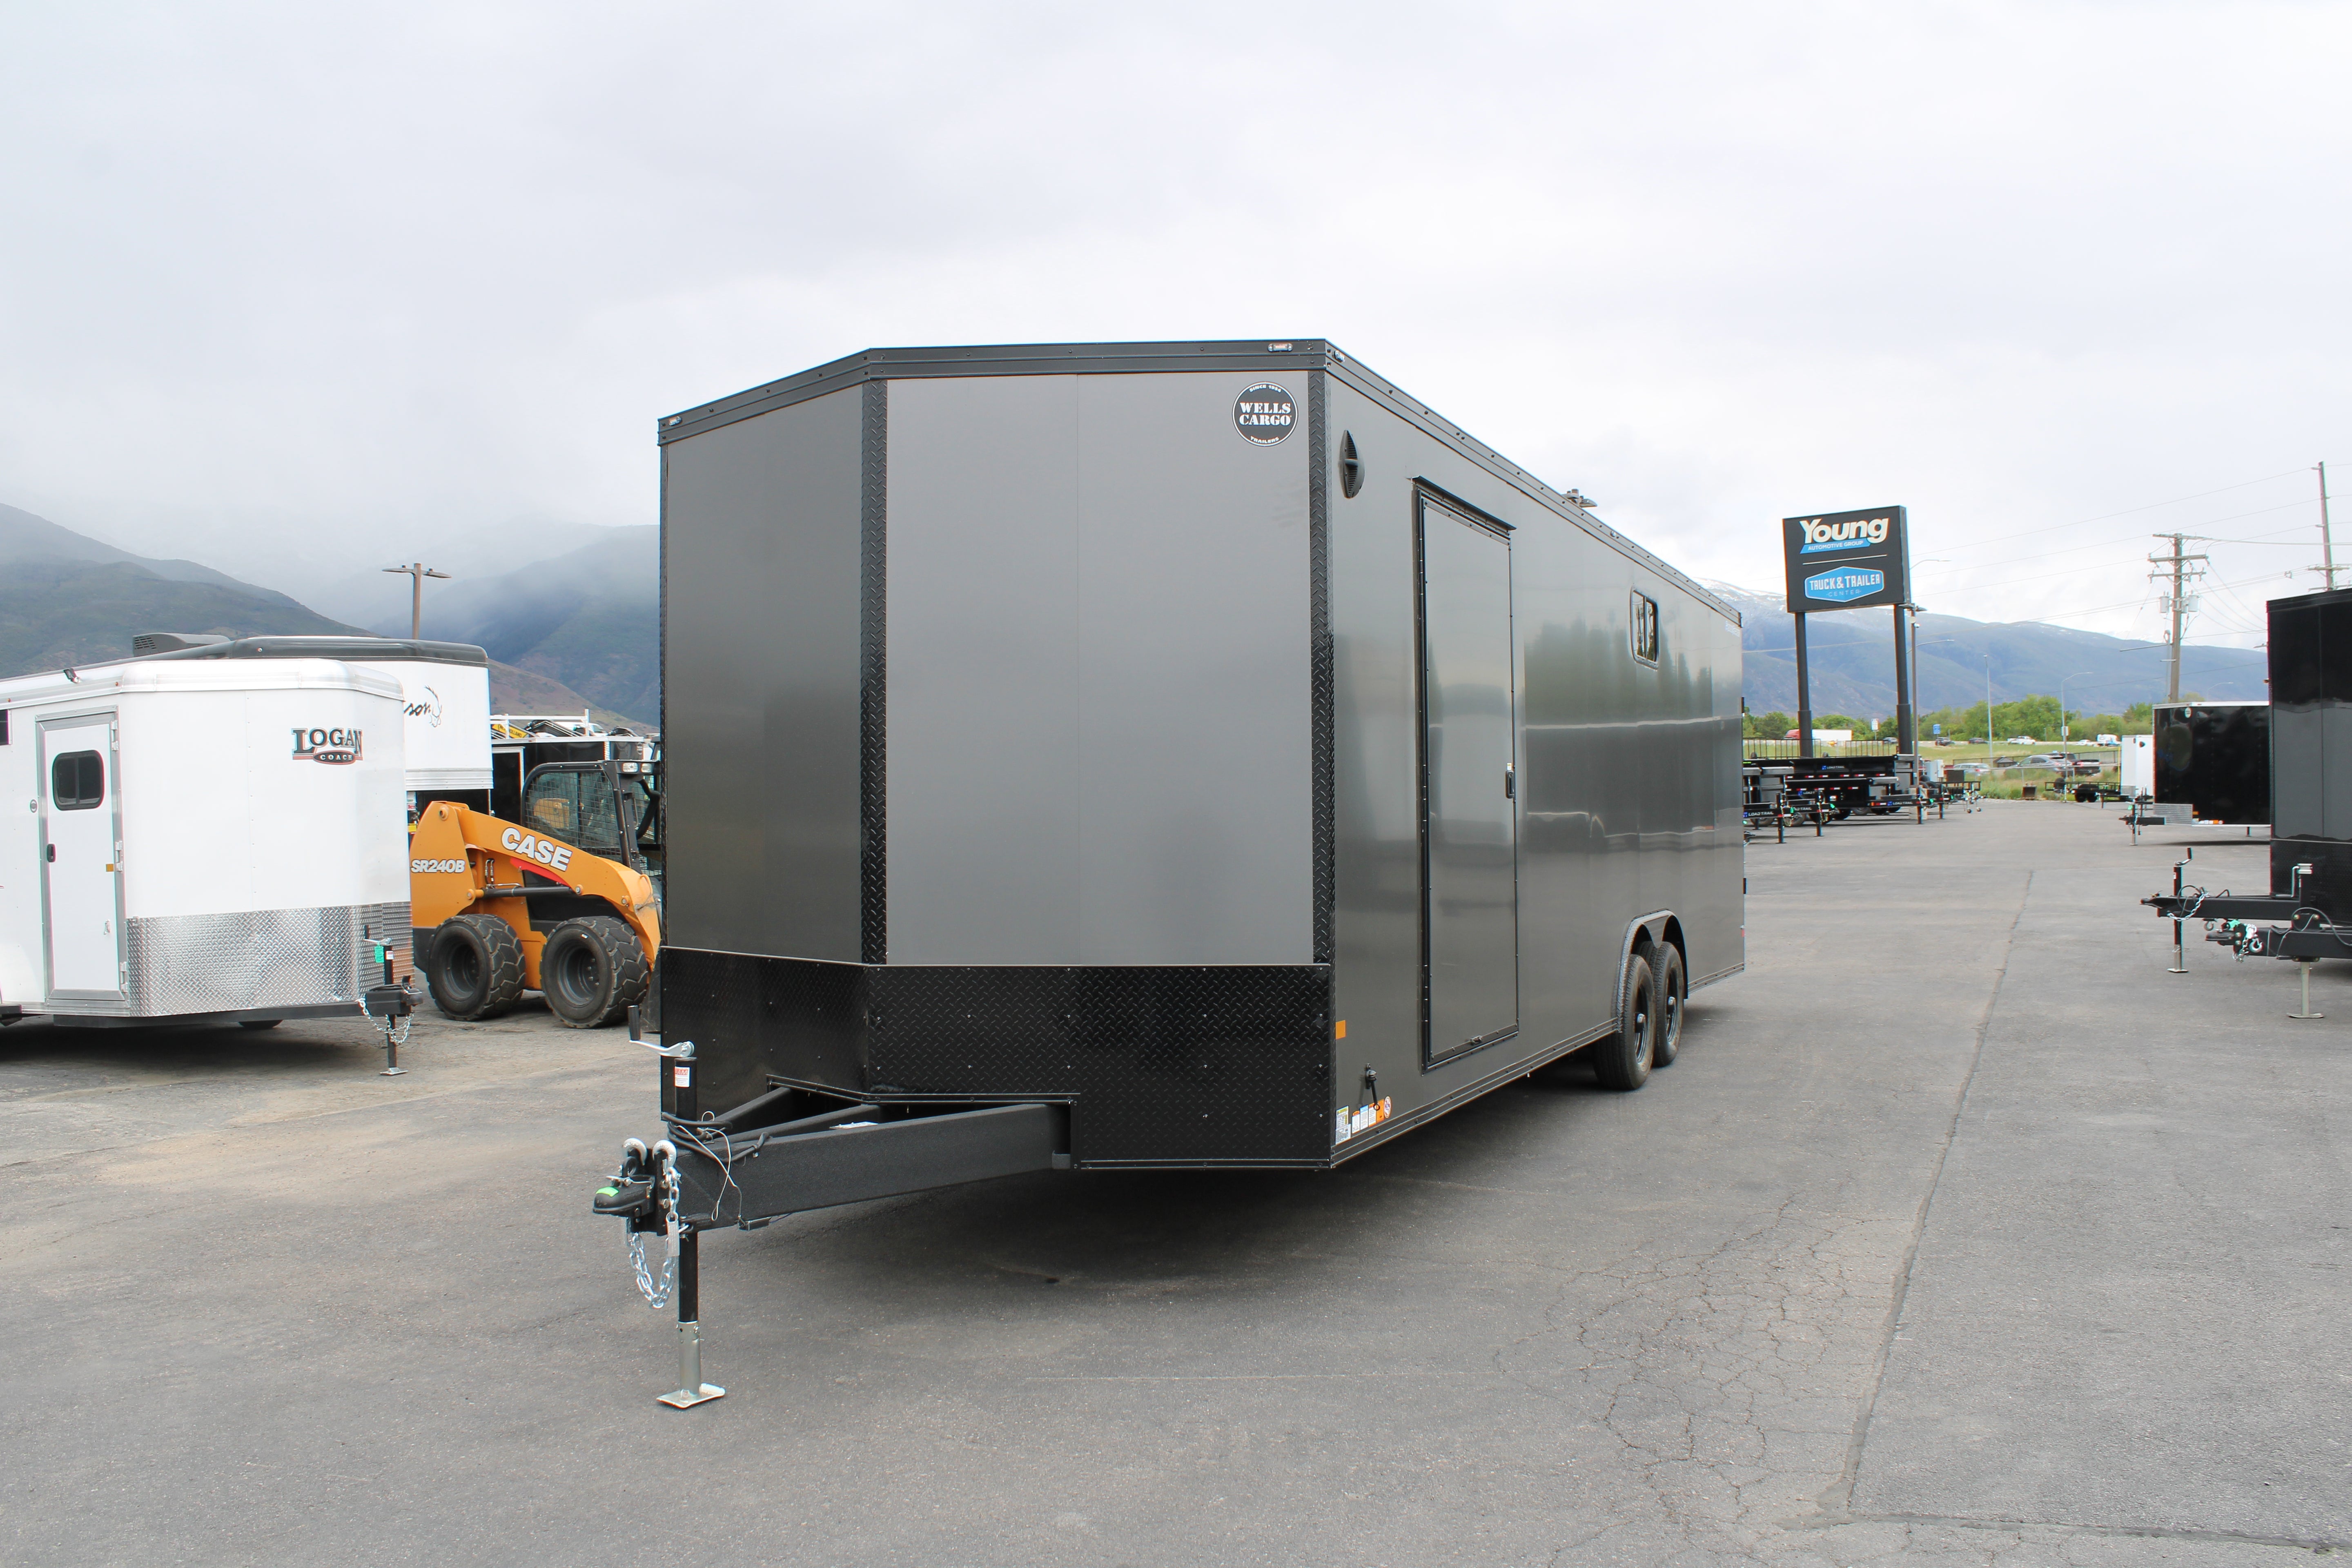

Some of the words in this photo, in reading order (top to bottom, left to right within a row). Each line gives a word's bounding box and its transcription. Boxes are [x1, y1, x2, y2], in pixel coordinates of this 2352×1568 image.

[1269, 385, 1281, 393] 1954
[1240, 402, 1291, 414] WELLS
[1239, 414, 1291, 426] CARGO
[1250, 435, 1279, 444] TRAILERS
[1799, 518, 1889, 543] Young
[1808, 543, 1843, 551] AUTOMOTIVE
[1809, 577, 1836, 591] TRUCK
[1836, 577, 1844, 589] &
[1844, 573, 1881, 588] TRAILER
[292, 728, 363, 755] LOGAN
[501, 827, 572, 872] CASE
[411, 859, 466, 873] SR240B
